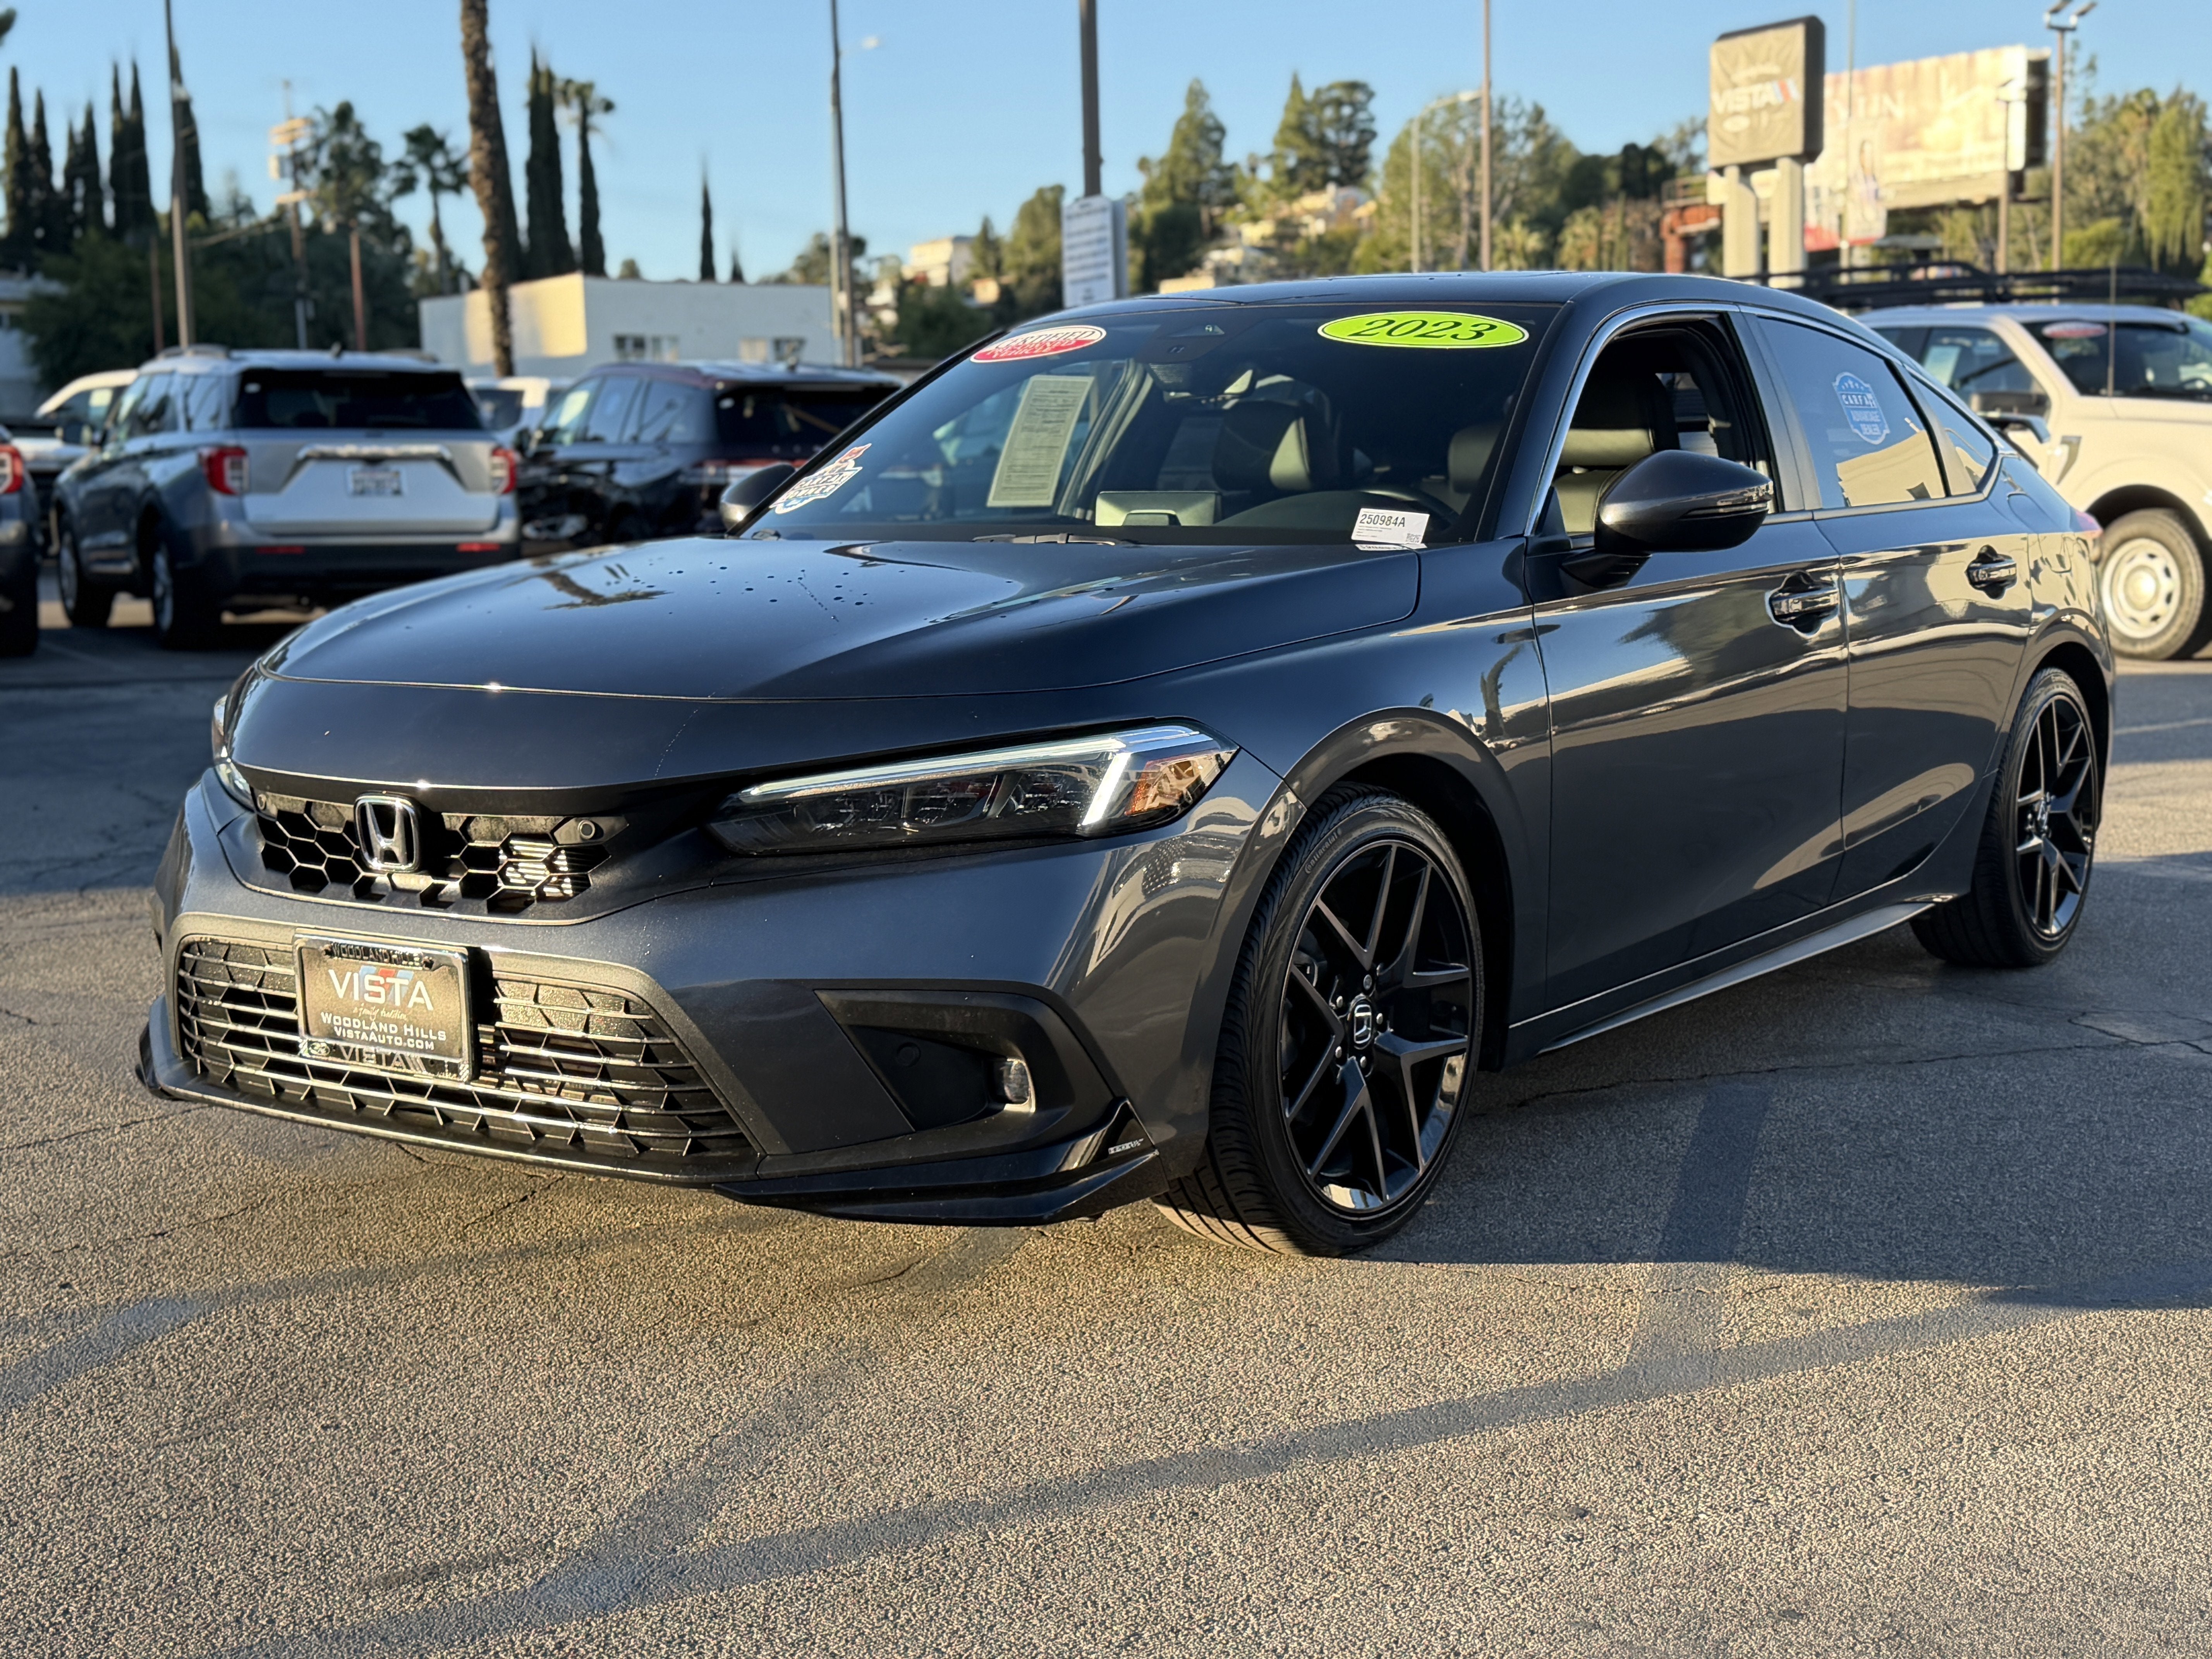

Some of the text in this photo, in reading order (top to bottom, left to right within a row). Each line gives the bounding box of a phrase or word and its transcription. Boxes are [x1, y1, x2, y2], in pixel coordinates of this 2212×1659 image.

[1711, 81, 1781, 114] VISTA
[995, 331, 1096, 349] CERTIFIED
[1346, 319, 1498, 341] 2023
[1359, 514, 1405, 527] 250984A
[329, 969, 433, 1010] VISTA
[321, 1012, 446, 1041] WOODLAND HILLS
[334, 1026, 434, 1050] VISTAAUTO.COM
